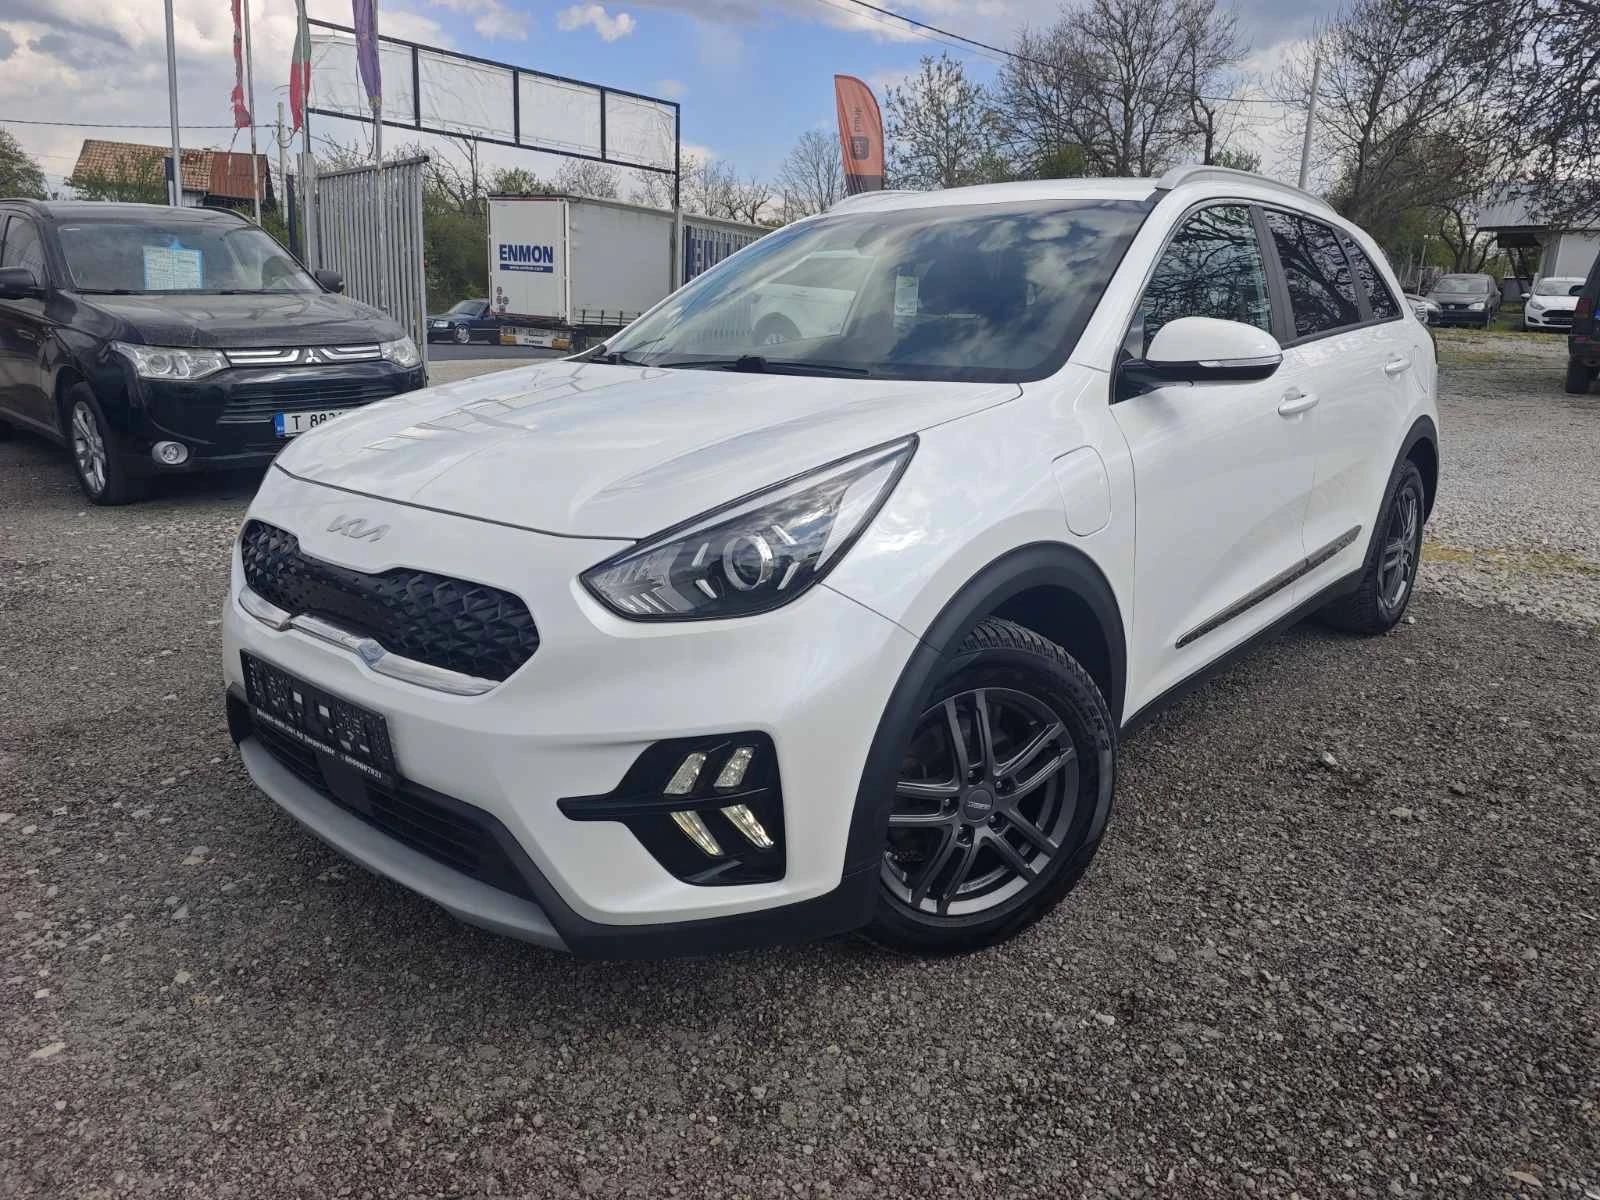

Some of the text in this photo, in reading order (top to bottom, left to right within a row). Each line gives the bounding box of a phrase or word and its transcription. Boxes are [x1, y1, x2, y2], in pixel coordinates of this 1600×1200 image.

[499, 244, 553, 263] ENMON
[292, 415, 301, 430] T
[327, 514, 391, 543] KIA
